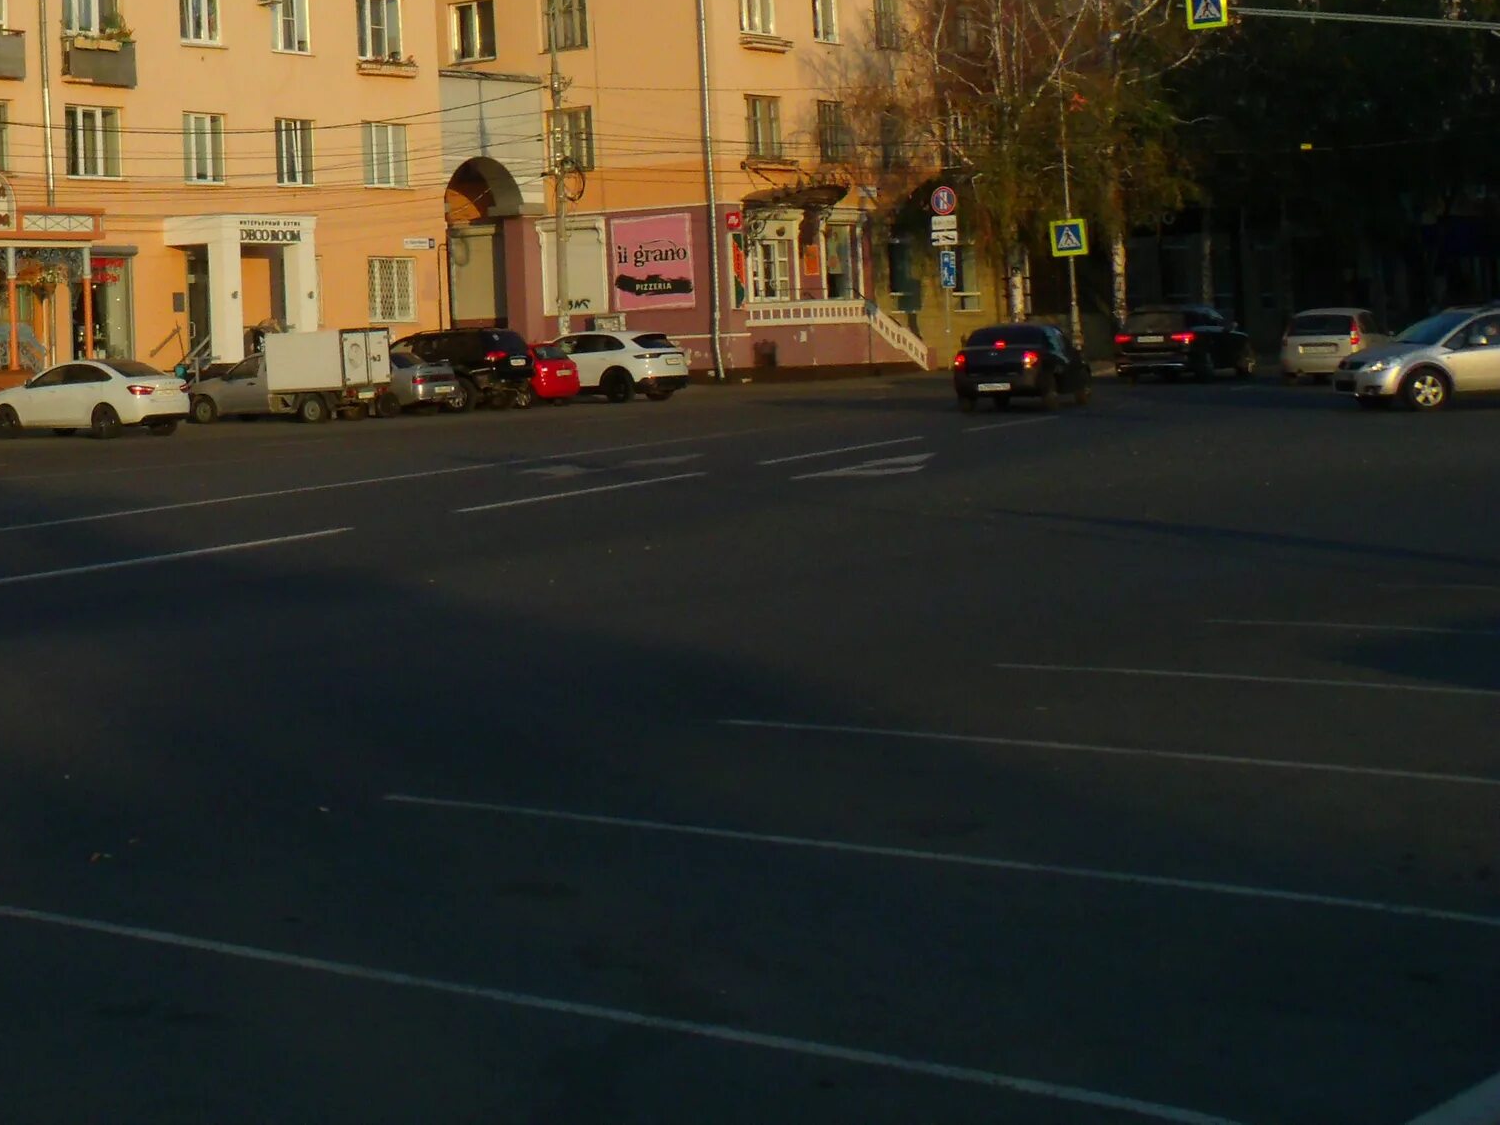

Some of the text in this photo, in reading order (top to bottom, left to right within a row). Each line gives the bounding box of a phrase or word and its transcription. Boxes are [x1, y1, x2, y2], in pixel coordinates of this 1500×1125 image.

[240, 228, 301, 242] DECO ROOM
[633, 244, 687, 268] grano
[635, 283, 672, 291] PIZZERIA
